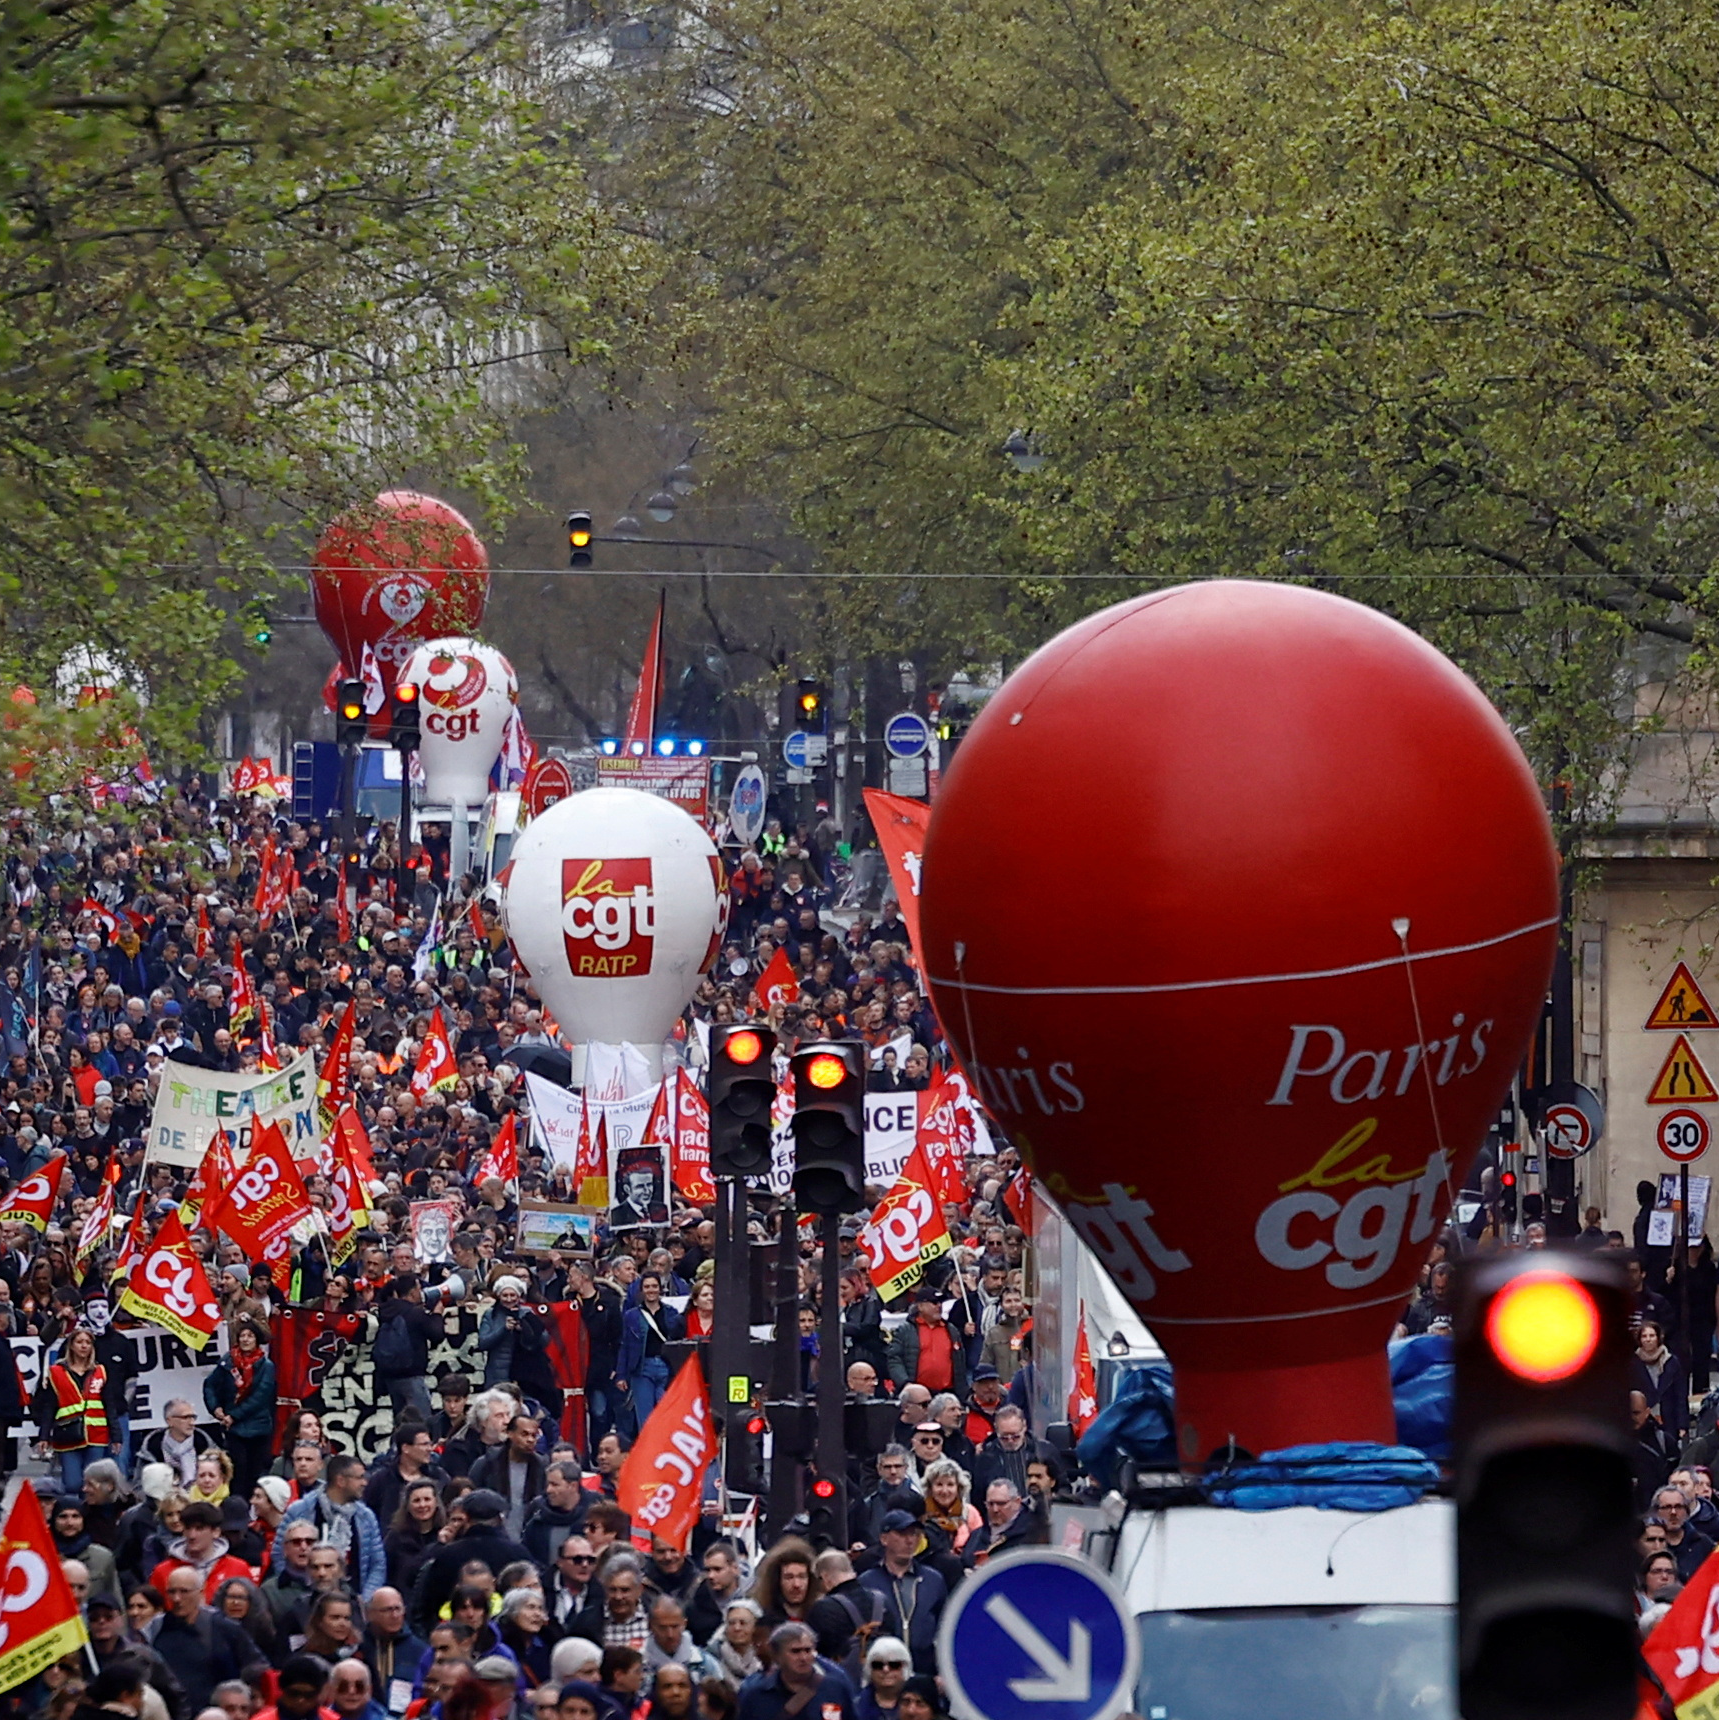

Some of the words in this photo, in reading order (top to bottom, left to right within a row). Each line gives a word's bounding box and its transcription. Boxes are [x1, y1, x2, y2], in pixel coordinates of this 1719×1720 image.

[426, 708, 480, 741] cgt
[565, 859, 653, 899] la
[561, 885, 655, 950] cgt
[579, 955, 637, 974] RATP
[337, 1052, 349, 1097] RATP
[1265, 1013, 1494, 1106] Paris
[158, 1126, 186, 1150] DE
[680, 1128, 709, 1148] rad
[1279, 1117, 1455, 1194] la
[1667, 1122, 1699, 1148] 30
[1255, 1149, 1453, 1289] cgt
[1065, 1182, 1193, 1301] gt
